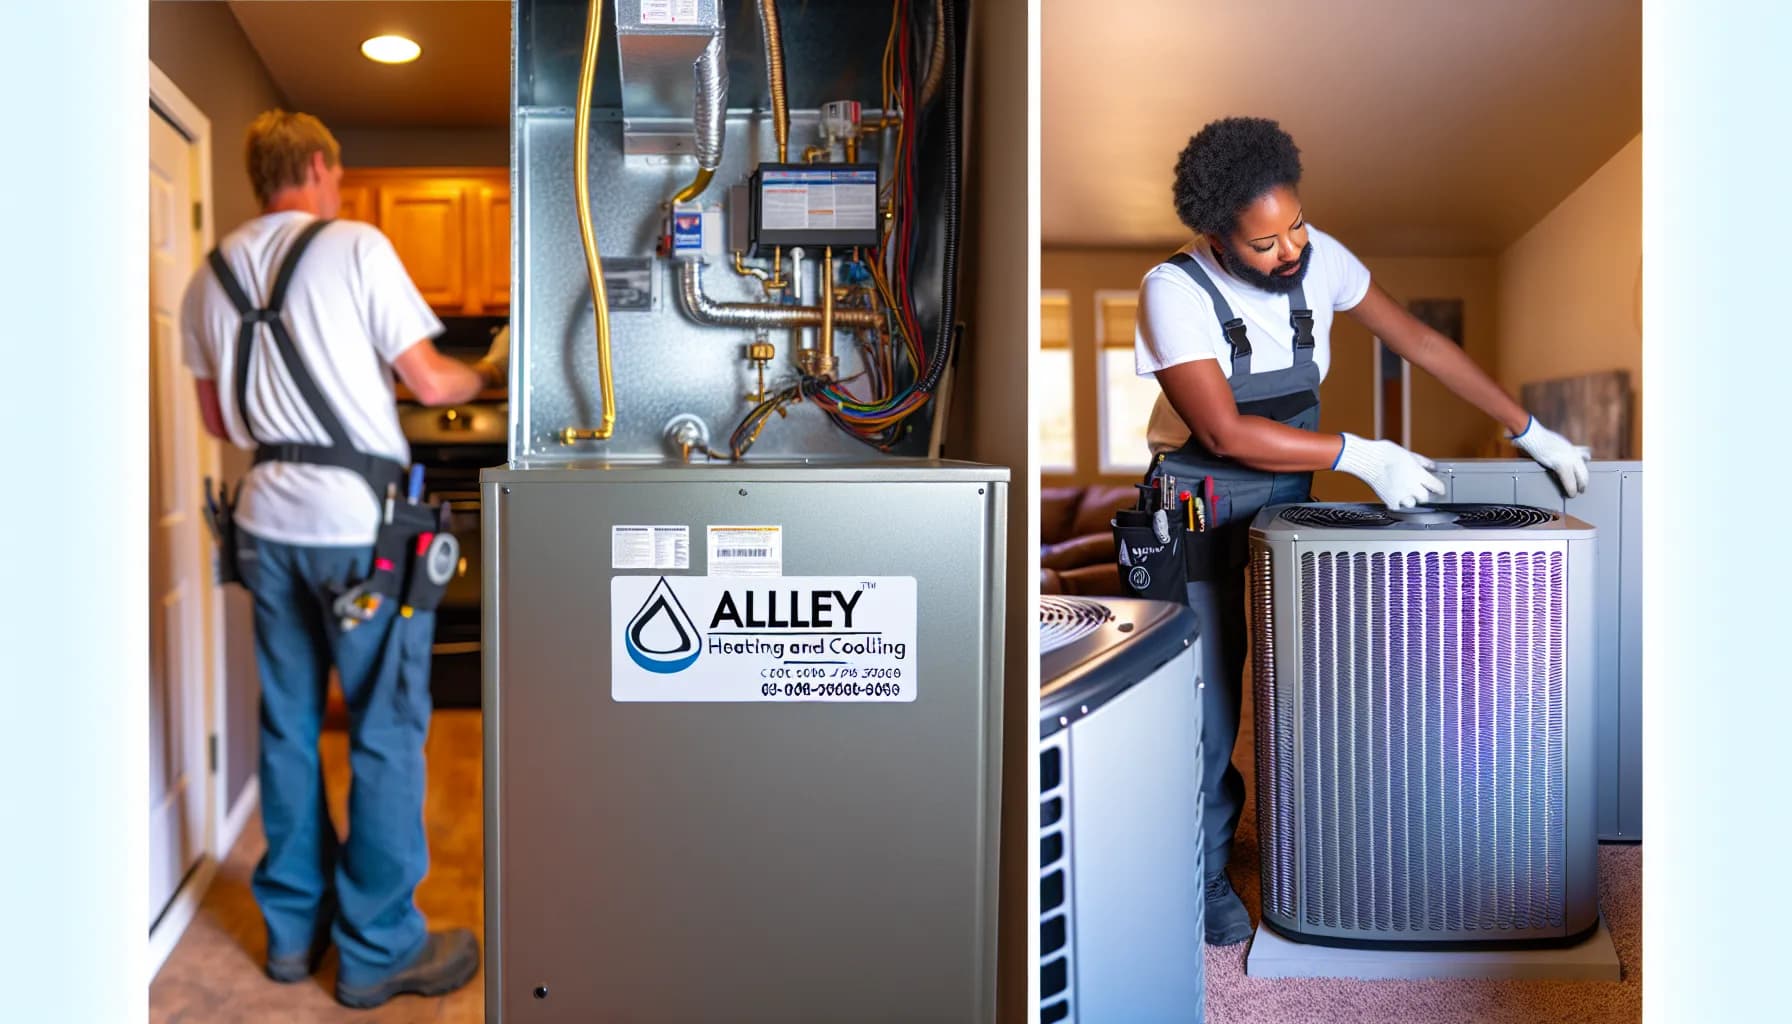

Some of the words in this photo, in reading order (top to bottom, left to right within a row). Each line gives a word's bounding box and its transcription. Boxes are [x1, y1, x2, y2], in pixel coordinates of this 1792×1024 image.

[709, 590, 863, 629] ALLLEY
[708, 637, 785, 659] Heating
[789, 638, 824, 654] and
